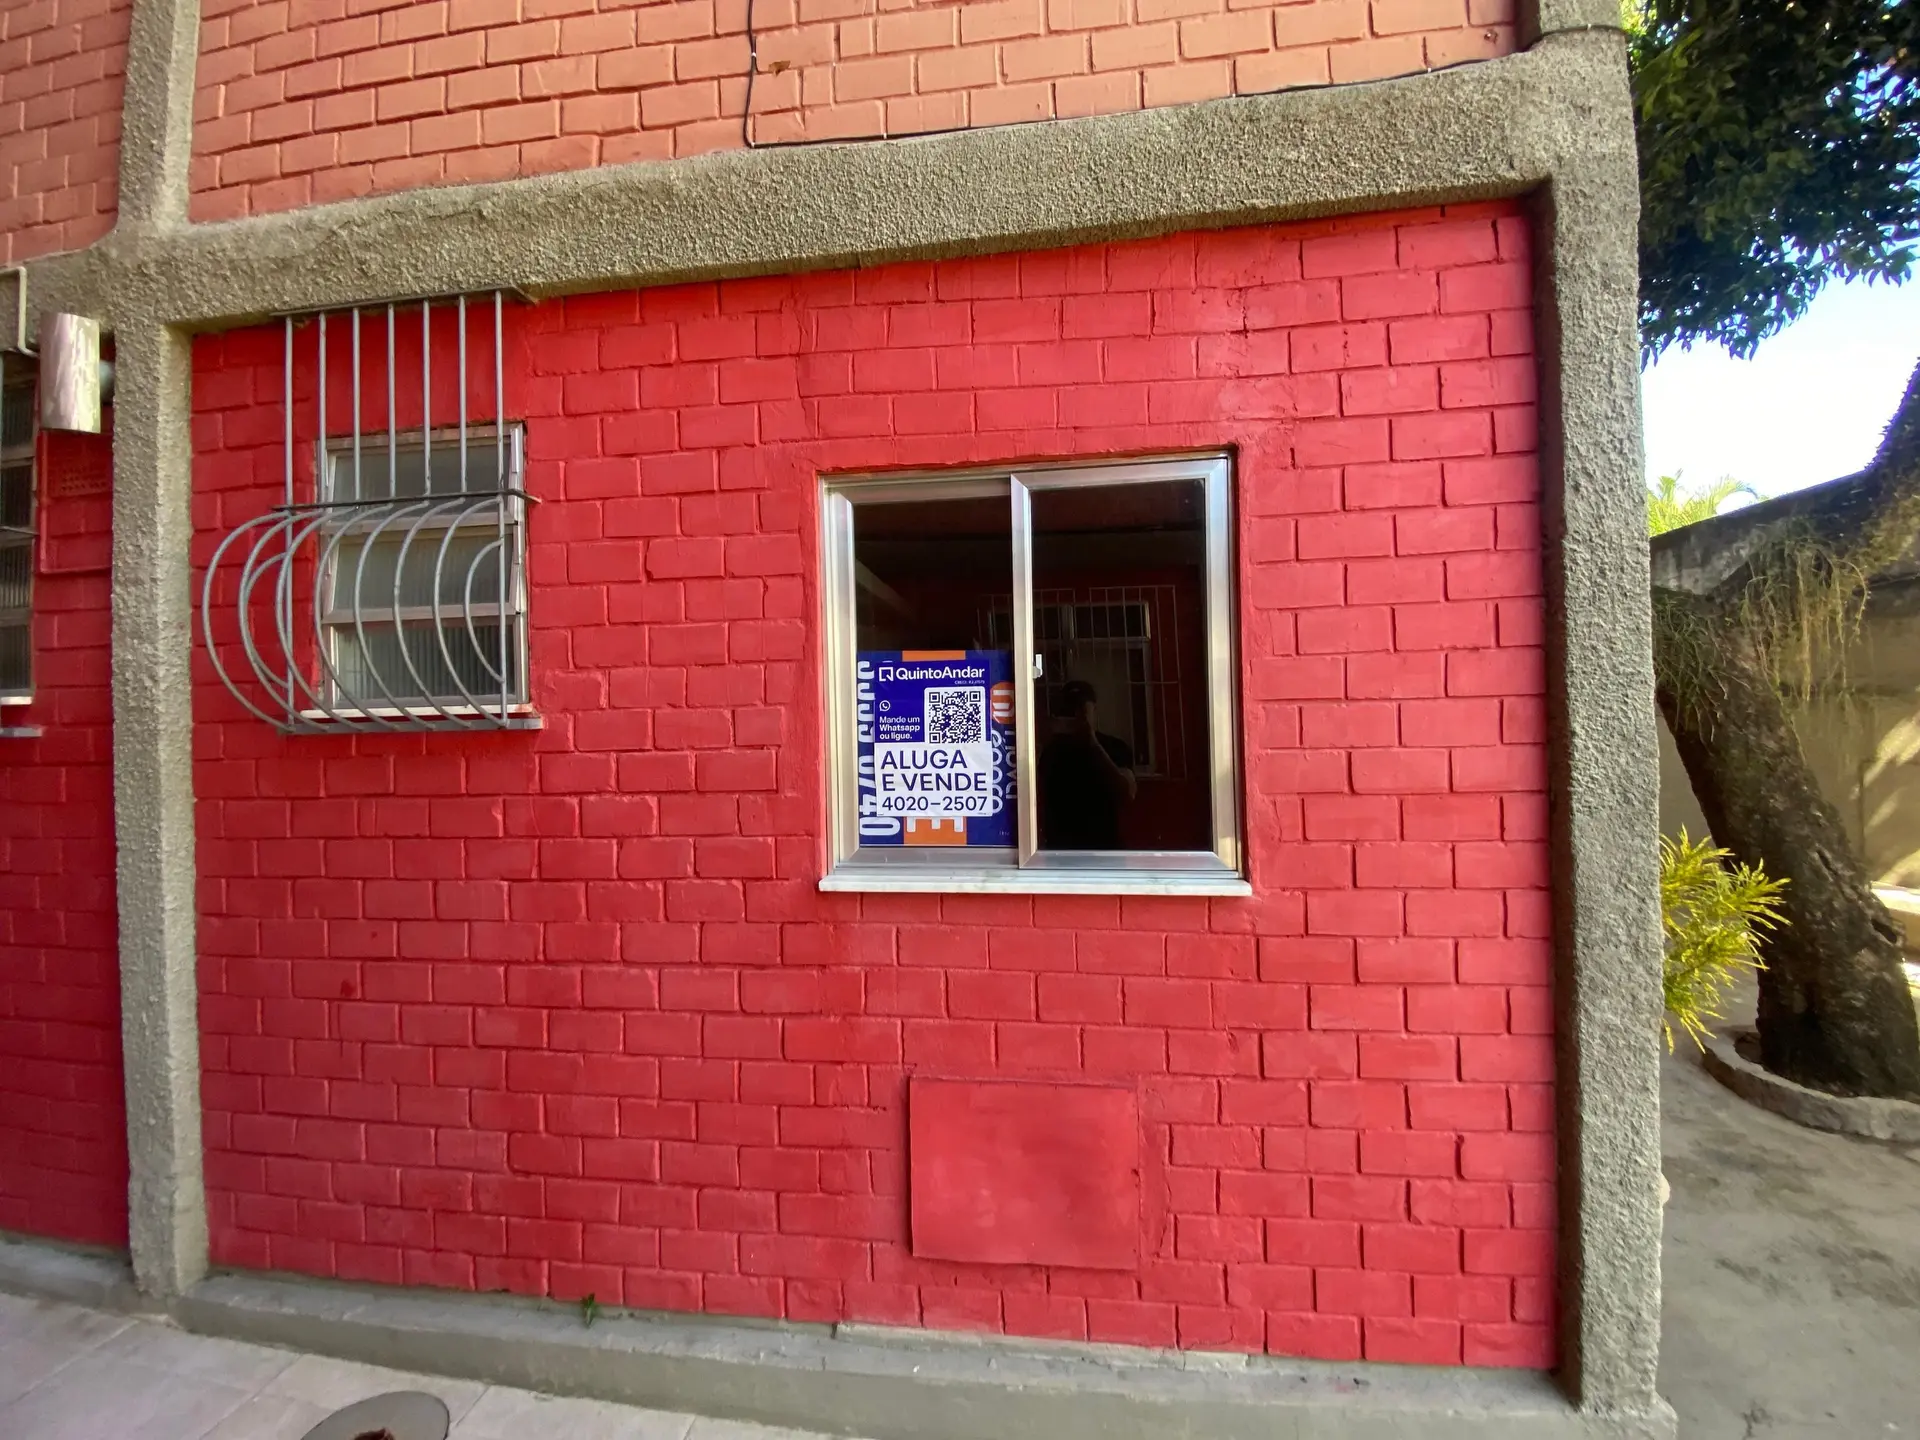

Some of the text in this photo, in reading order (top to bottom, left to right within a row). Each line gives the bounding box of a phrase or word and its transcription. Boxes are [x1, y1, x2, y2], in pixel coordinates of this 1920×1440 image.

[896, 666, 985, 681] QuintoAndar
[879, 716, 907, 724] Mande
[879, 724, 921, 732] Whatsapp
[891, 732, 913, 741] ligue.
[880, 749, 968, 770] ALUGA
[882, 772, 988, 791] E VENDE
[882, 796, 988, 811] 4020-2507
